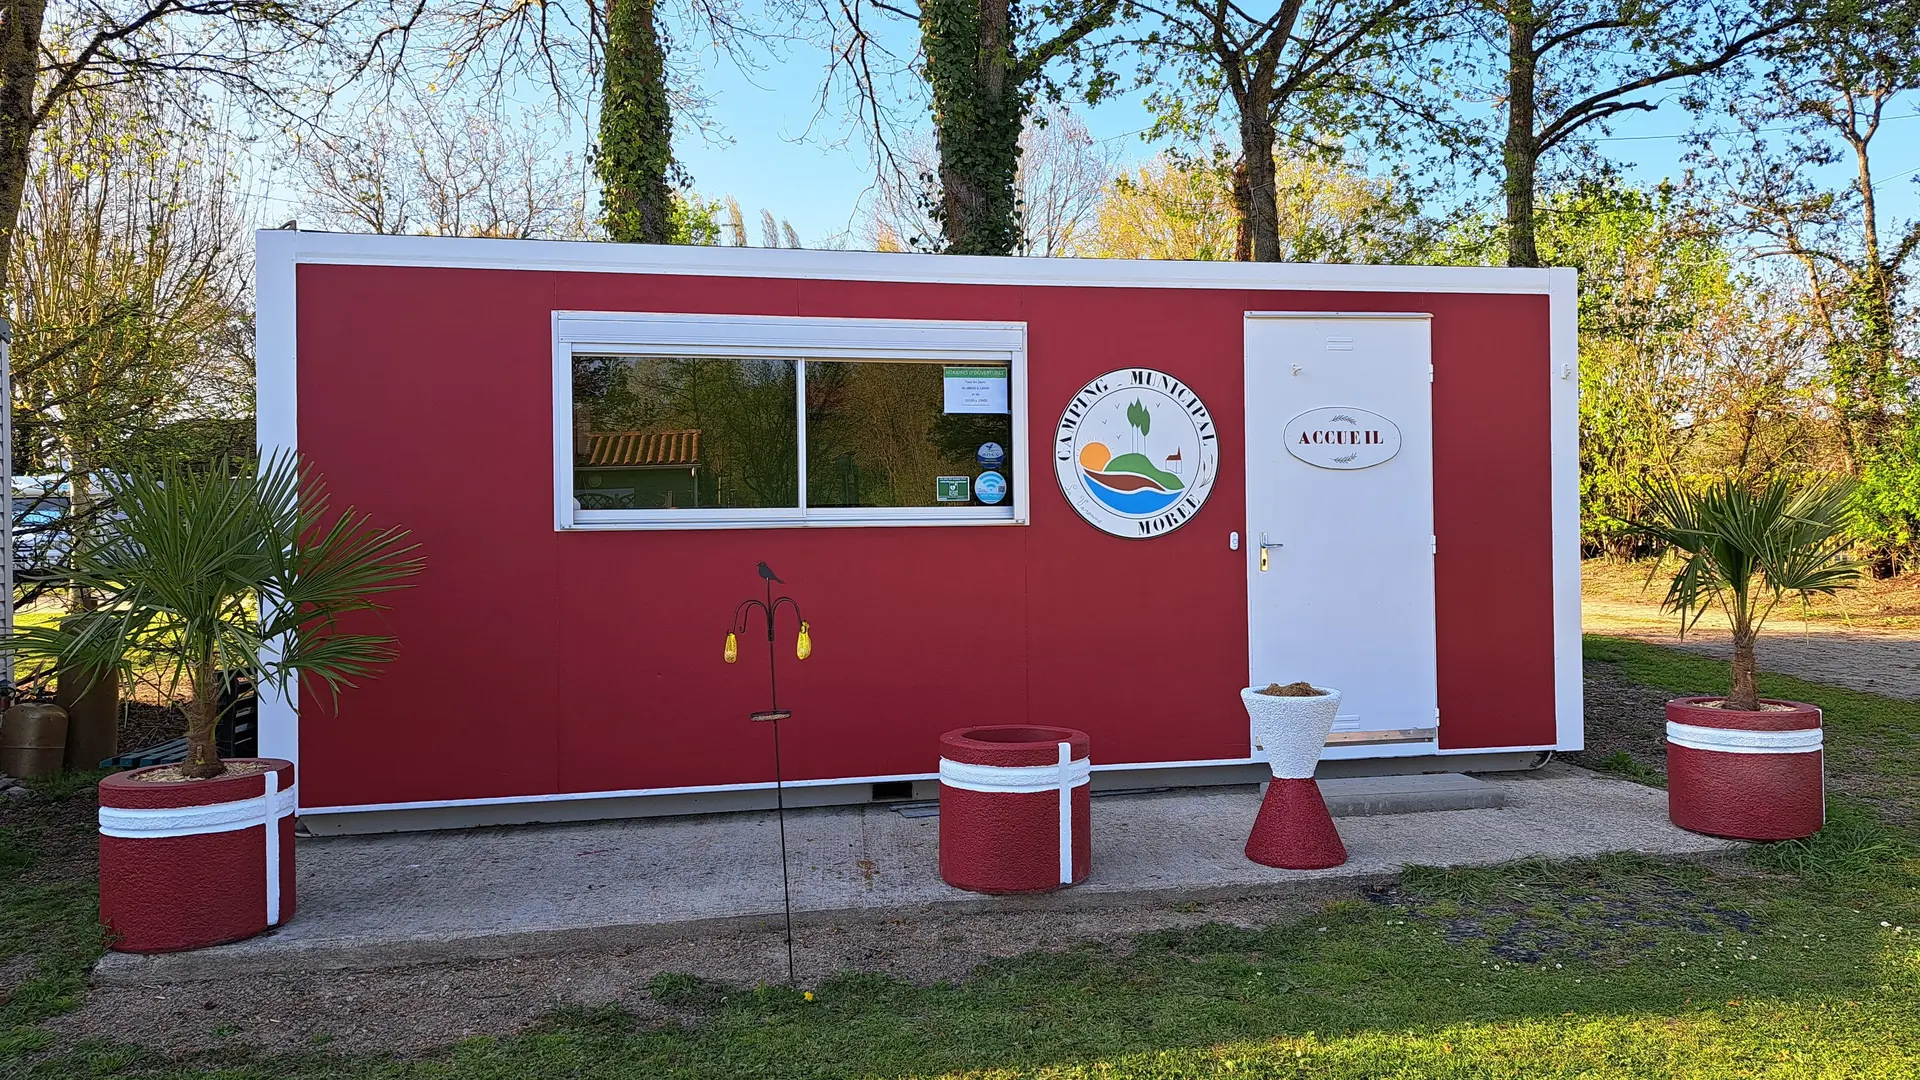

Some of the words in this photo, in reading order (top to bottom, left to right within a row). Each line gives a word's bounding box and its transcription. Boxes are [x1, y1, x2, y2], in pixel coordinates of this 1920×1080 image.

[1057, 378, 1109, 462] CAMPING
[1129, 370, 1215, 446] MUNICIPAL
[1298, 430, 1384, 445] ACCUEIL
[1137, 494, 1201, 536] MOREE
